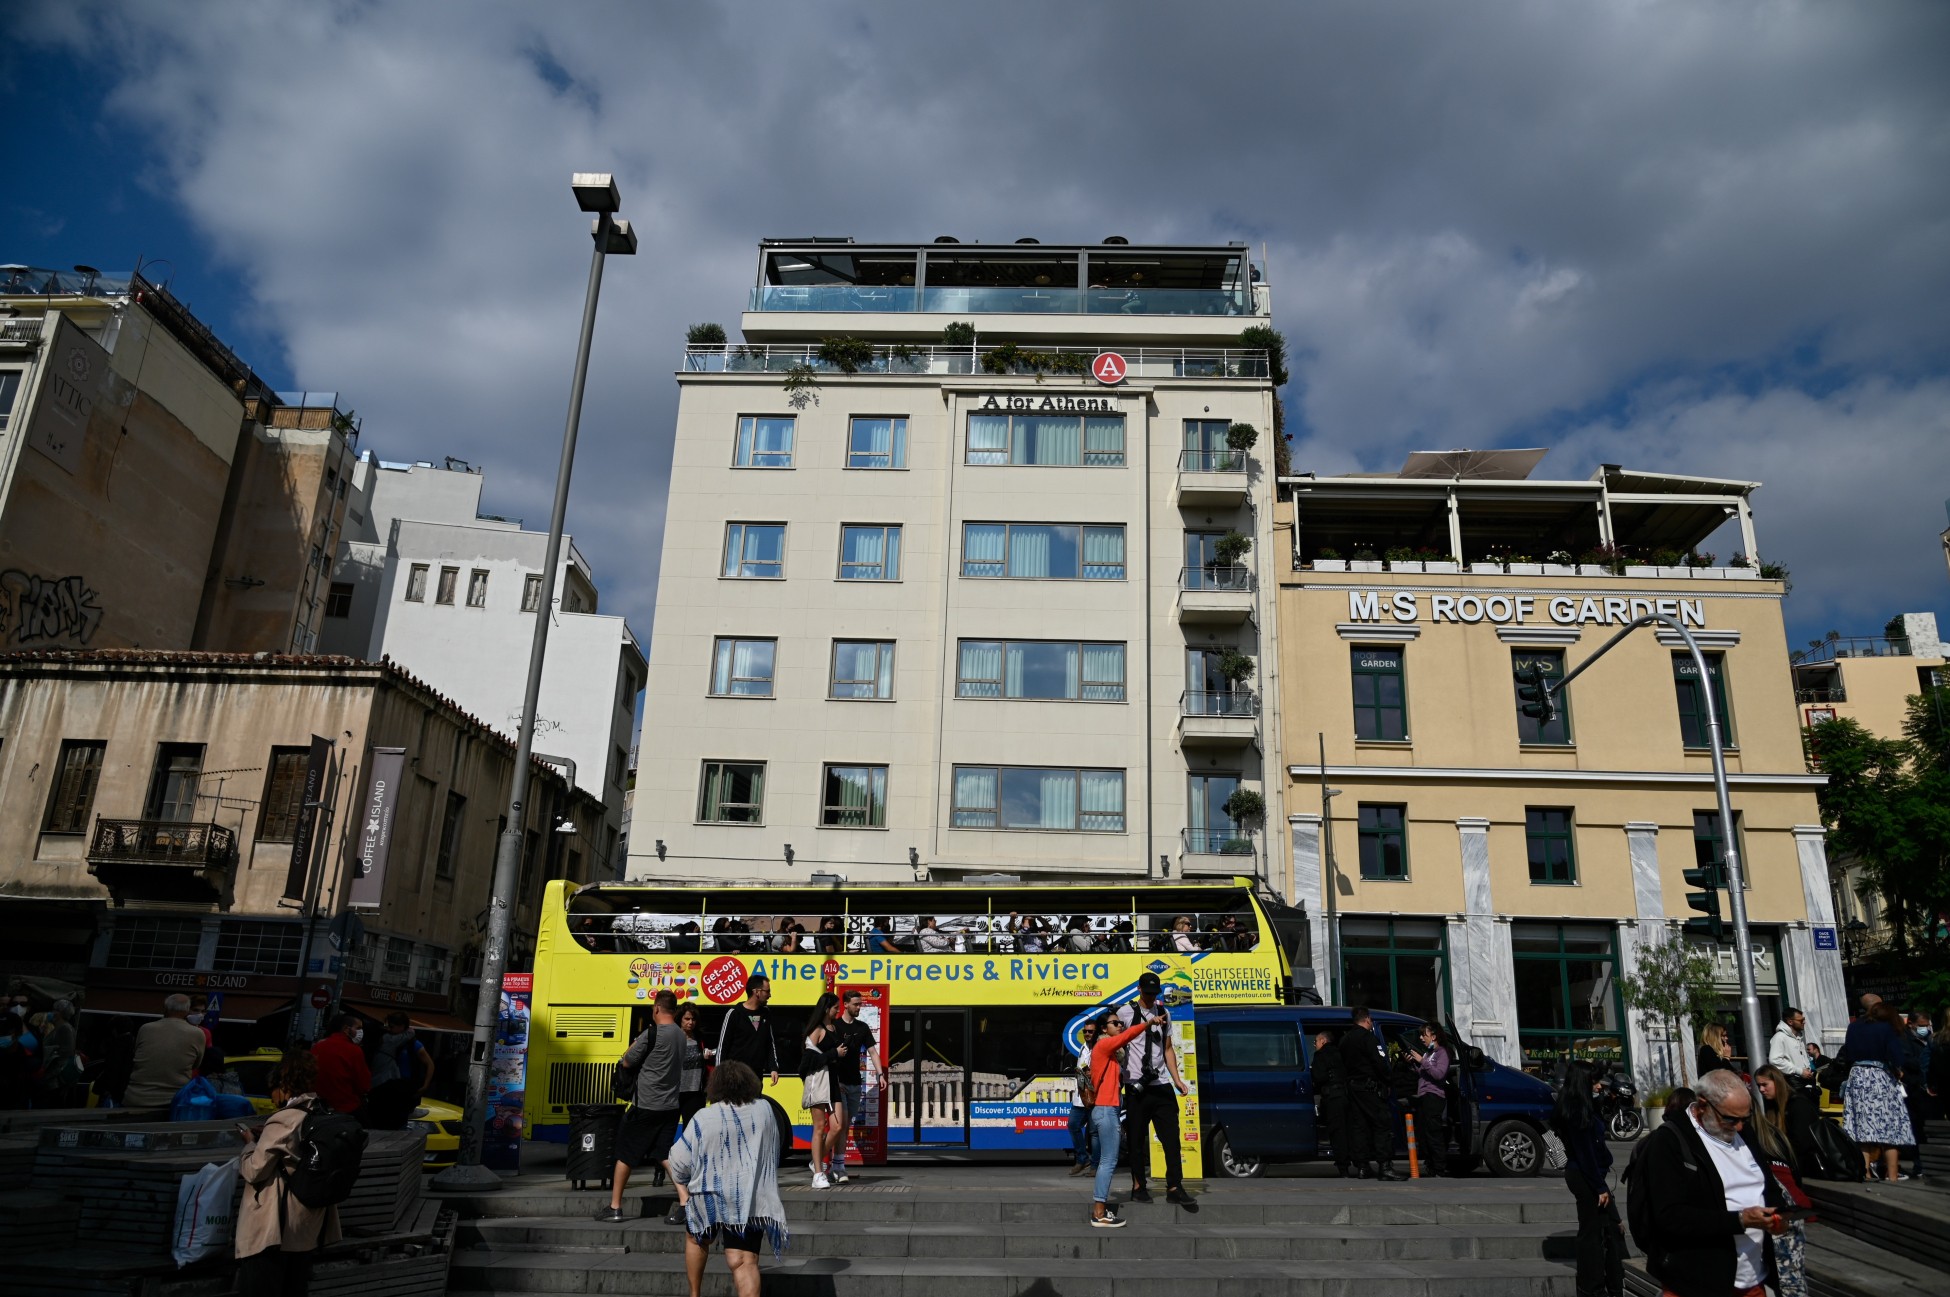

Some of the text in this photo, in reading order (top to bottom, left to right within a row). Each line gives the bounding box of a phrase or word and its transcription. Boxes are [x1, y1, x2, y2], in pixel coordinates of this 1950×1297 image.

[1098, 356, 1122, 377] A
[983, 394, 1000, 410] A
[1006, 393, 1034, 410] for
[1430, 594, 1535, 625] ROOF
[1548, 596, 1705, 628] GARDEN
[1360, 659, 1397, 668] GARDEN
[1679, 666, 1716, 674] GARN
[294, 769, 317, 865] COFFEE SLAND
[362, 780, 386, 873] COFFEE ISLAND
[1686, 942, 1771, 966] ATHR.
[631, 963, 655, 971] AUDIO
[702, 960, 735, 985] Get-on
[824, 963, 838, 973] A14
[982, 959, 1000, 981] &
[1009, 957, 1110, 981] Riviera
[1193, 967, 1271, 980] SIGHTSEEING
[1727, 967, 1759, 977] HOE
[154, 973, 248, 988] COFFEE ISLAND
[707, 967, 743, 995] Get-off
[1193, 979, 1272, 991] EVERYWHERE
[716, 980, 745, 1002] TOUR
[1040, 987, 1074, 997] Athens
[1530, 1048, 1560, 1059] Kebab
[1577, 1049, 1621, 1059] Mousaka
[974, 1106, 1072, 1116] Discover 5.000 years of his
[1041, 1119, 1056, 1127] tour
